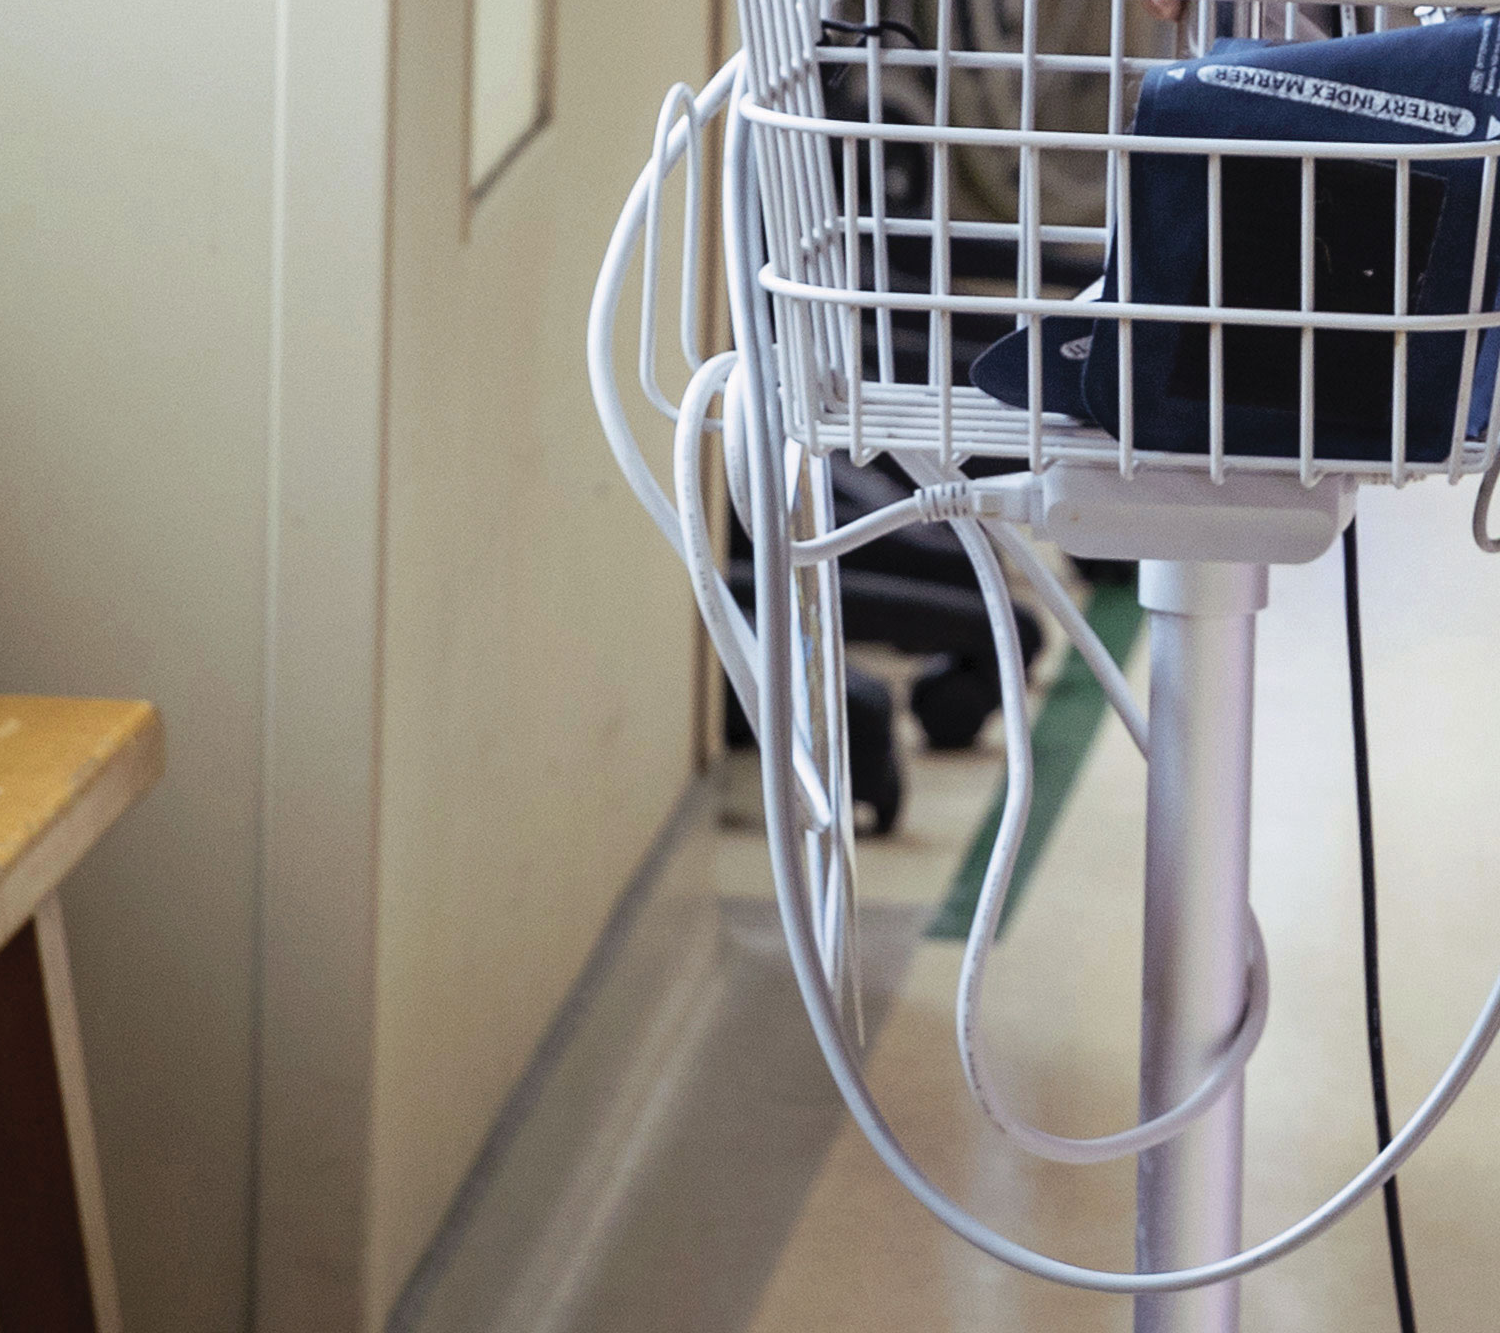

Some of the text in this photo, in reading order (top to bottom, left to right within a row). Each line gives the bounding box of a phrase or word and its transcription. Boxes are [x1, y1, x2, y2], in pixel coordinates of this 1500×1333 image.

[1214, 68, 1462, 129] ARTERY INDEX MARKER
